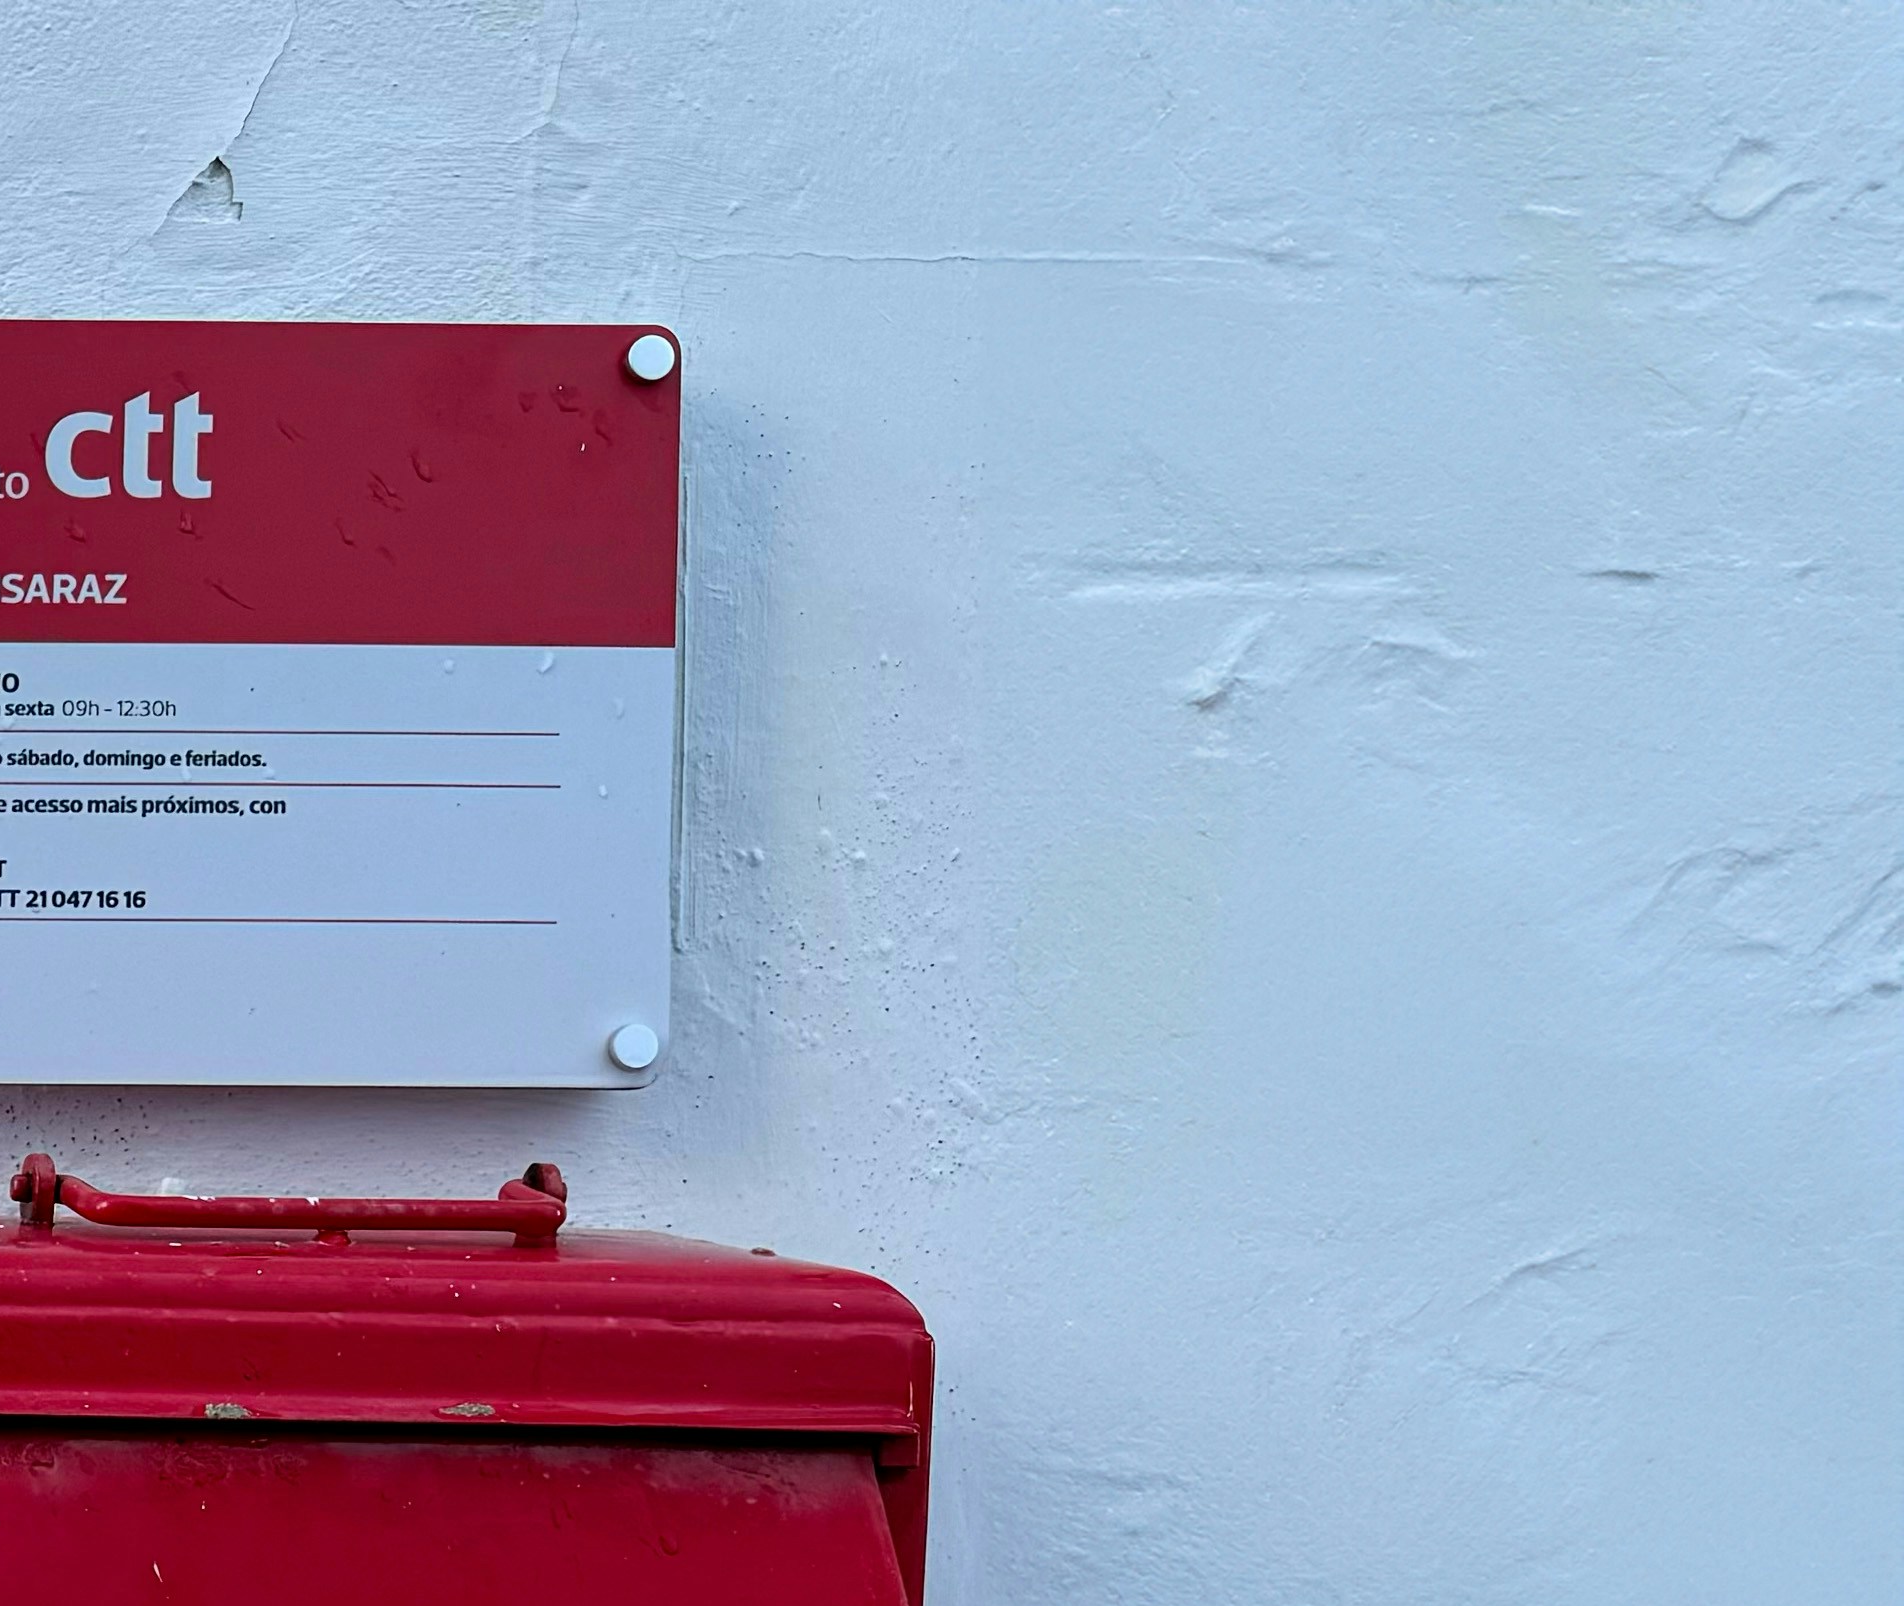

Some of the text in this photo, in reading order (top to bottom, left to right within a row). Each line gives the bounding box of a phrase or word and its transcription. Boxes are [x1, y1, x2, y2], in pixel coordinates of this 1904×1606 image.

[45, 390, 214, 500] ctt
[4, 700, 55, 717] sexta
[62, 699, 100, 717] 09h
[117, 700, 177, 717] 12:30h
[6, 748, 80, 769] sábado,
[82, 749, 166, 770] domingo
[169, 753, 182, 767] e
[185, 749, 267, 767] feriados.
[11, 798, 83, 814] acesso
[87, 795, 138, 814] mais
[141, 795, 245, 818] próximos,
[249, 800, 287, 815] con
[96, 890, 119, 909] 16
[123, 890, 146, 909] 16
